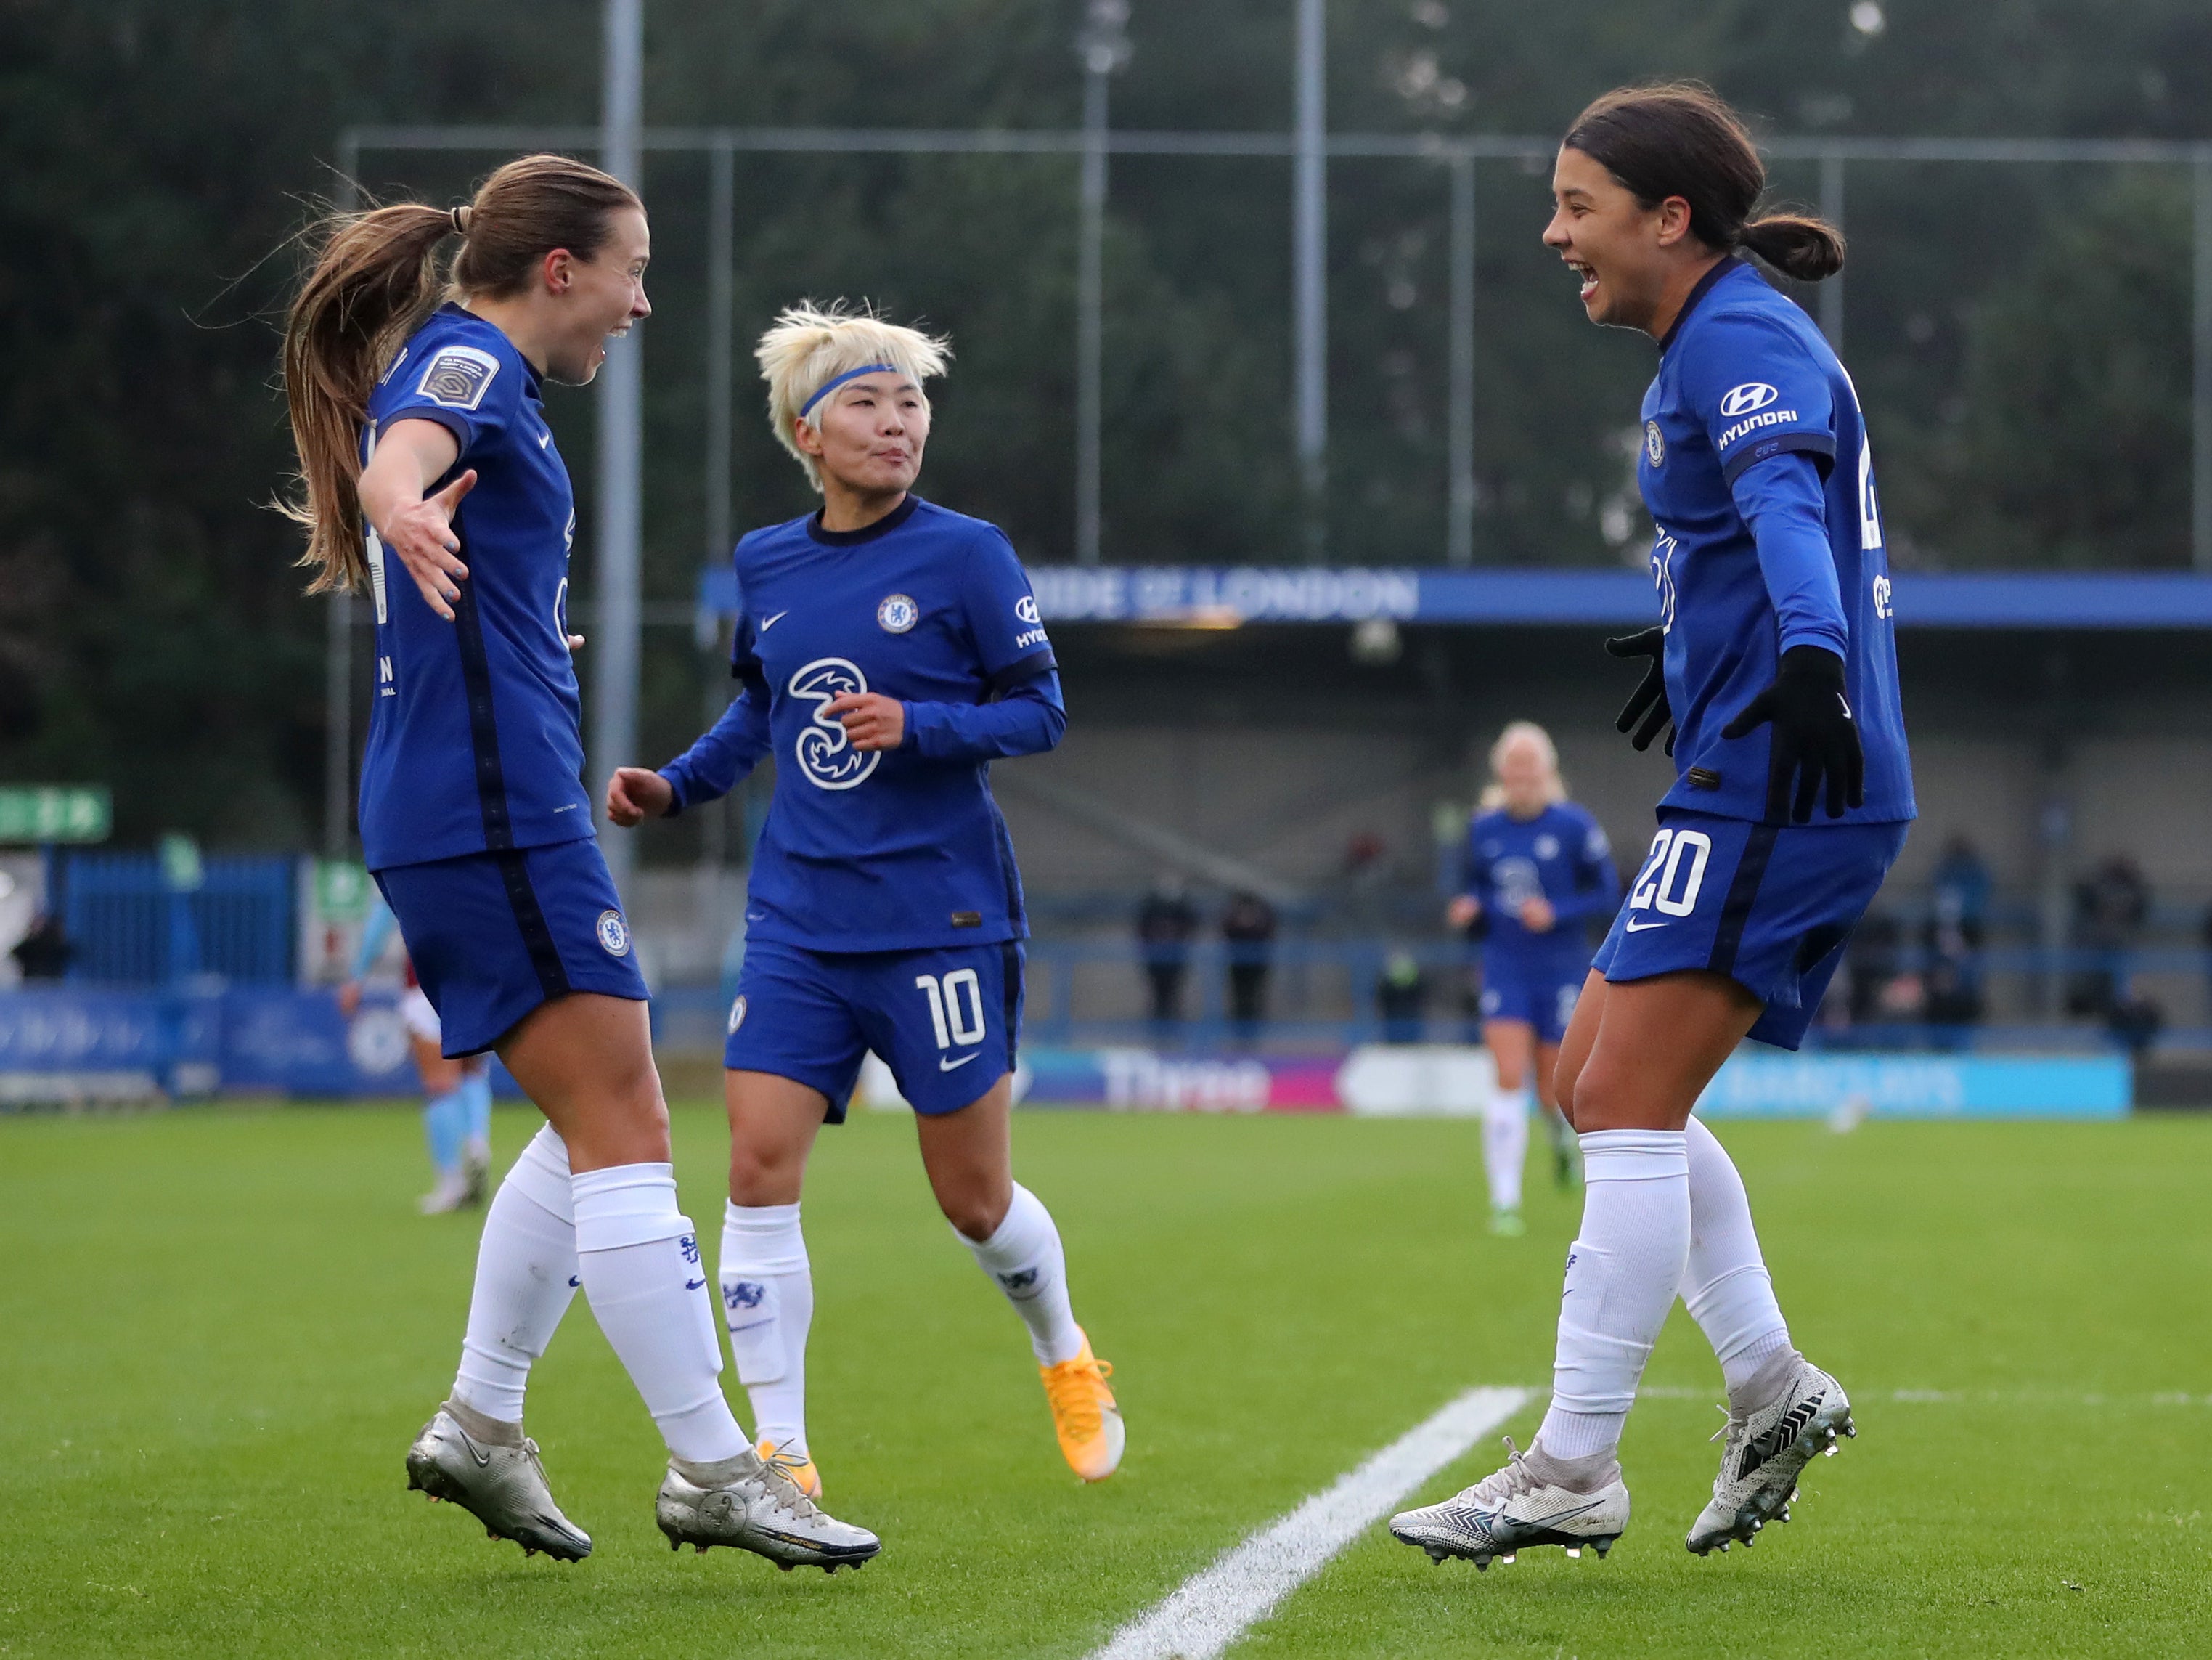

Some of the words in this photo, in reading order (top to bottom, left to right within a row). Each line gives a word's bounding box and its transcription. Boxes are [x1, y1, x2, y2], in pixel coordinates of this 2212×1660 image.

[1718, 410, 1798, 451] HYUNDAI
[1630, 829, 1712, 917] 20
[915, 967, 986, 1050] 10
